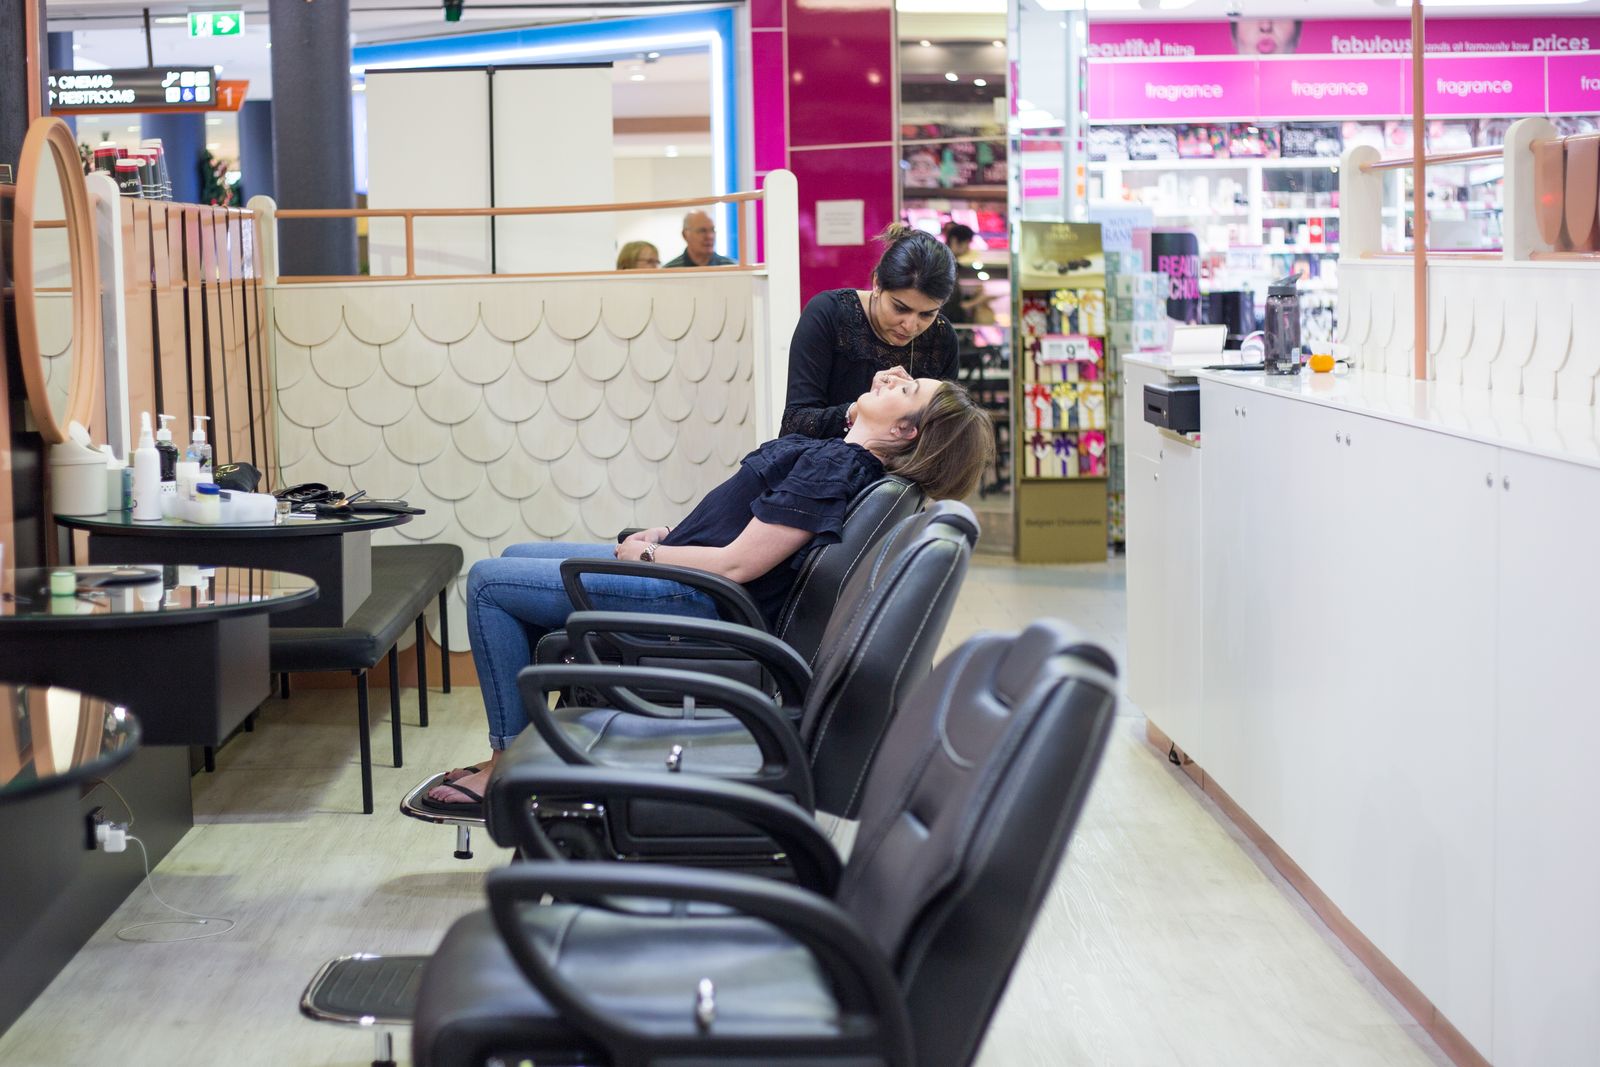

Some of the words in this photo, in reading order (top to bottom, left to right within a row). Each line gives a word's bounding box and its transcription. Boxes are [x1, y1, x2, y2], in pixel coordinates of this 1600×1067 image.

[1088, 38, 1160, 57] eautiful
[1331, 34, 1413, 54] fabulous
[1533, 34, 1590, 52] prices
[58, 74, 114, 90] CINEMAS
[1291, 79, 1369, 100] fragrance
[1436, 77, 1513, 98] fragrance
[58, 89, 136, 105] RESTROOMS
[223, 86, 233, 108] 1
[1145, 82, 1224, 103] fragrance
[1066, 344, 1076, 361] 9
